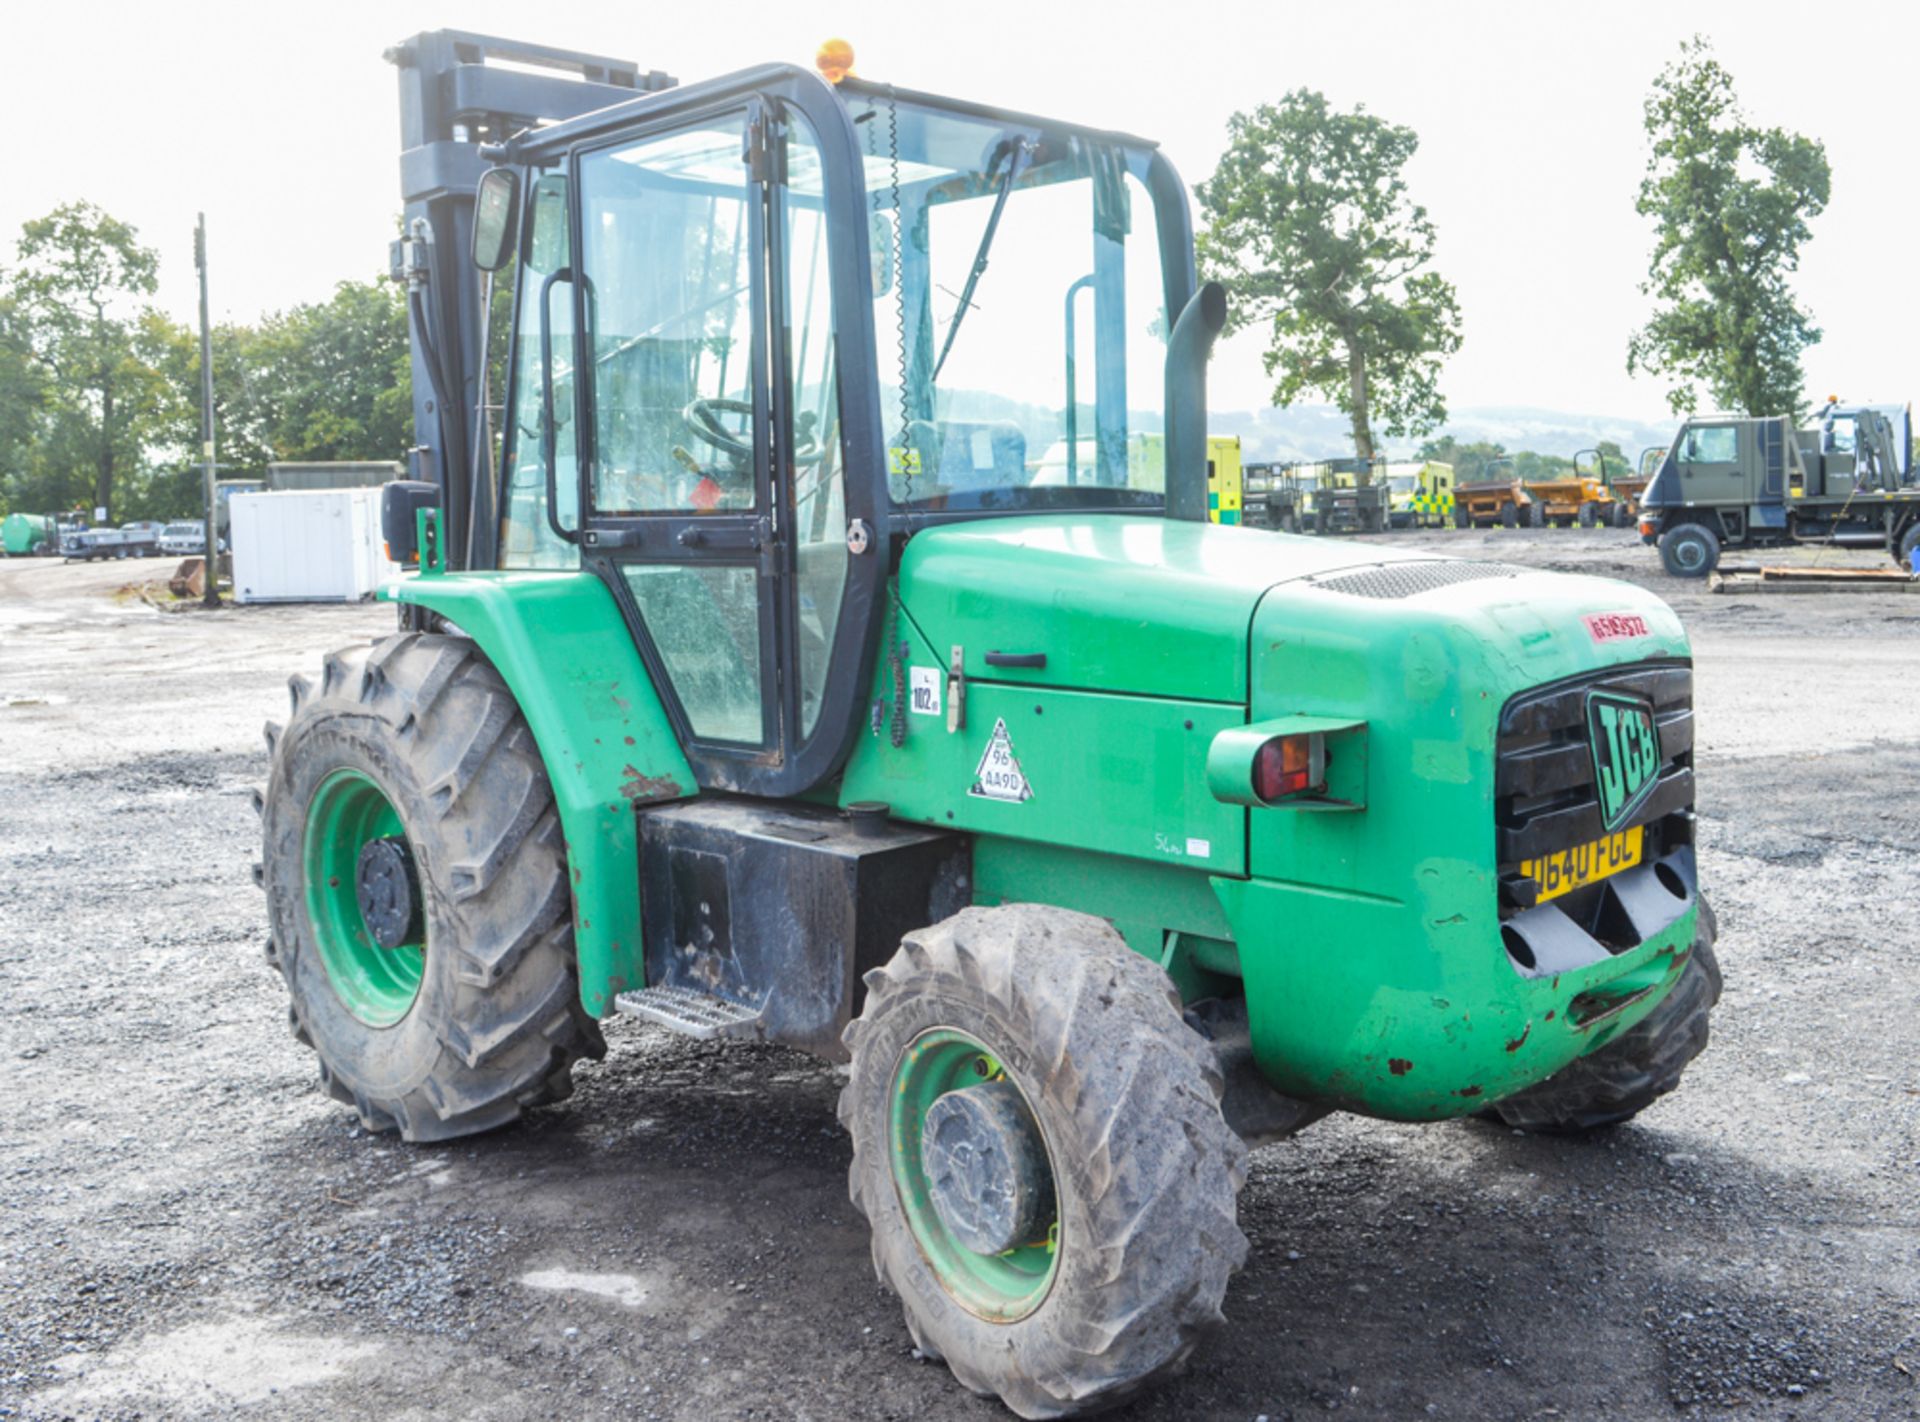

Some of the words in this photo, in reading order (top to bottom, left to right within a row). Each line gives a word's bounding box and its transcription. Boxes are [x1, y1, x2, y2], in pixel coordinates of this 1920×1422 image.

[914, 687, 931, 710] 102
[993, 749, 1009, 766] 96
[1598, 704, 1656, 818] JCB
